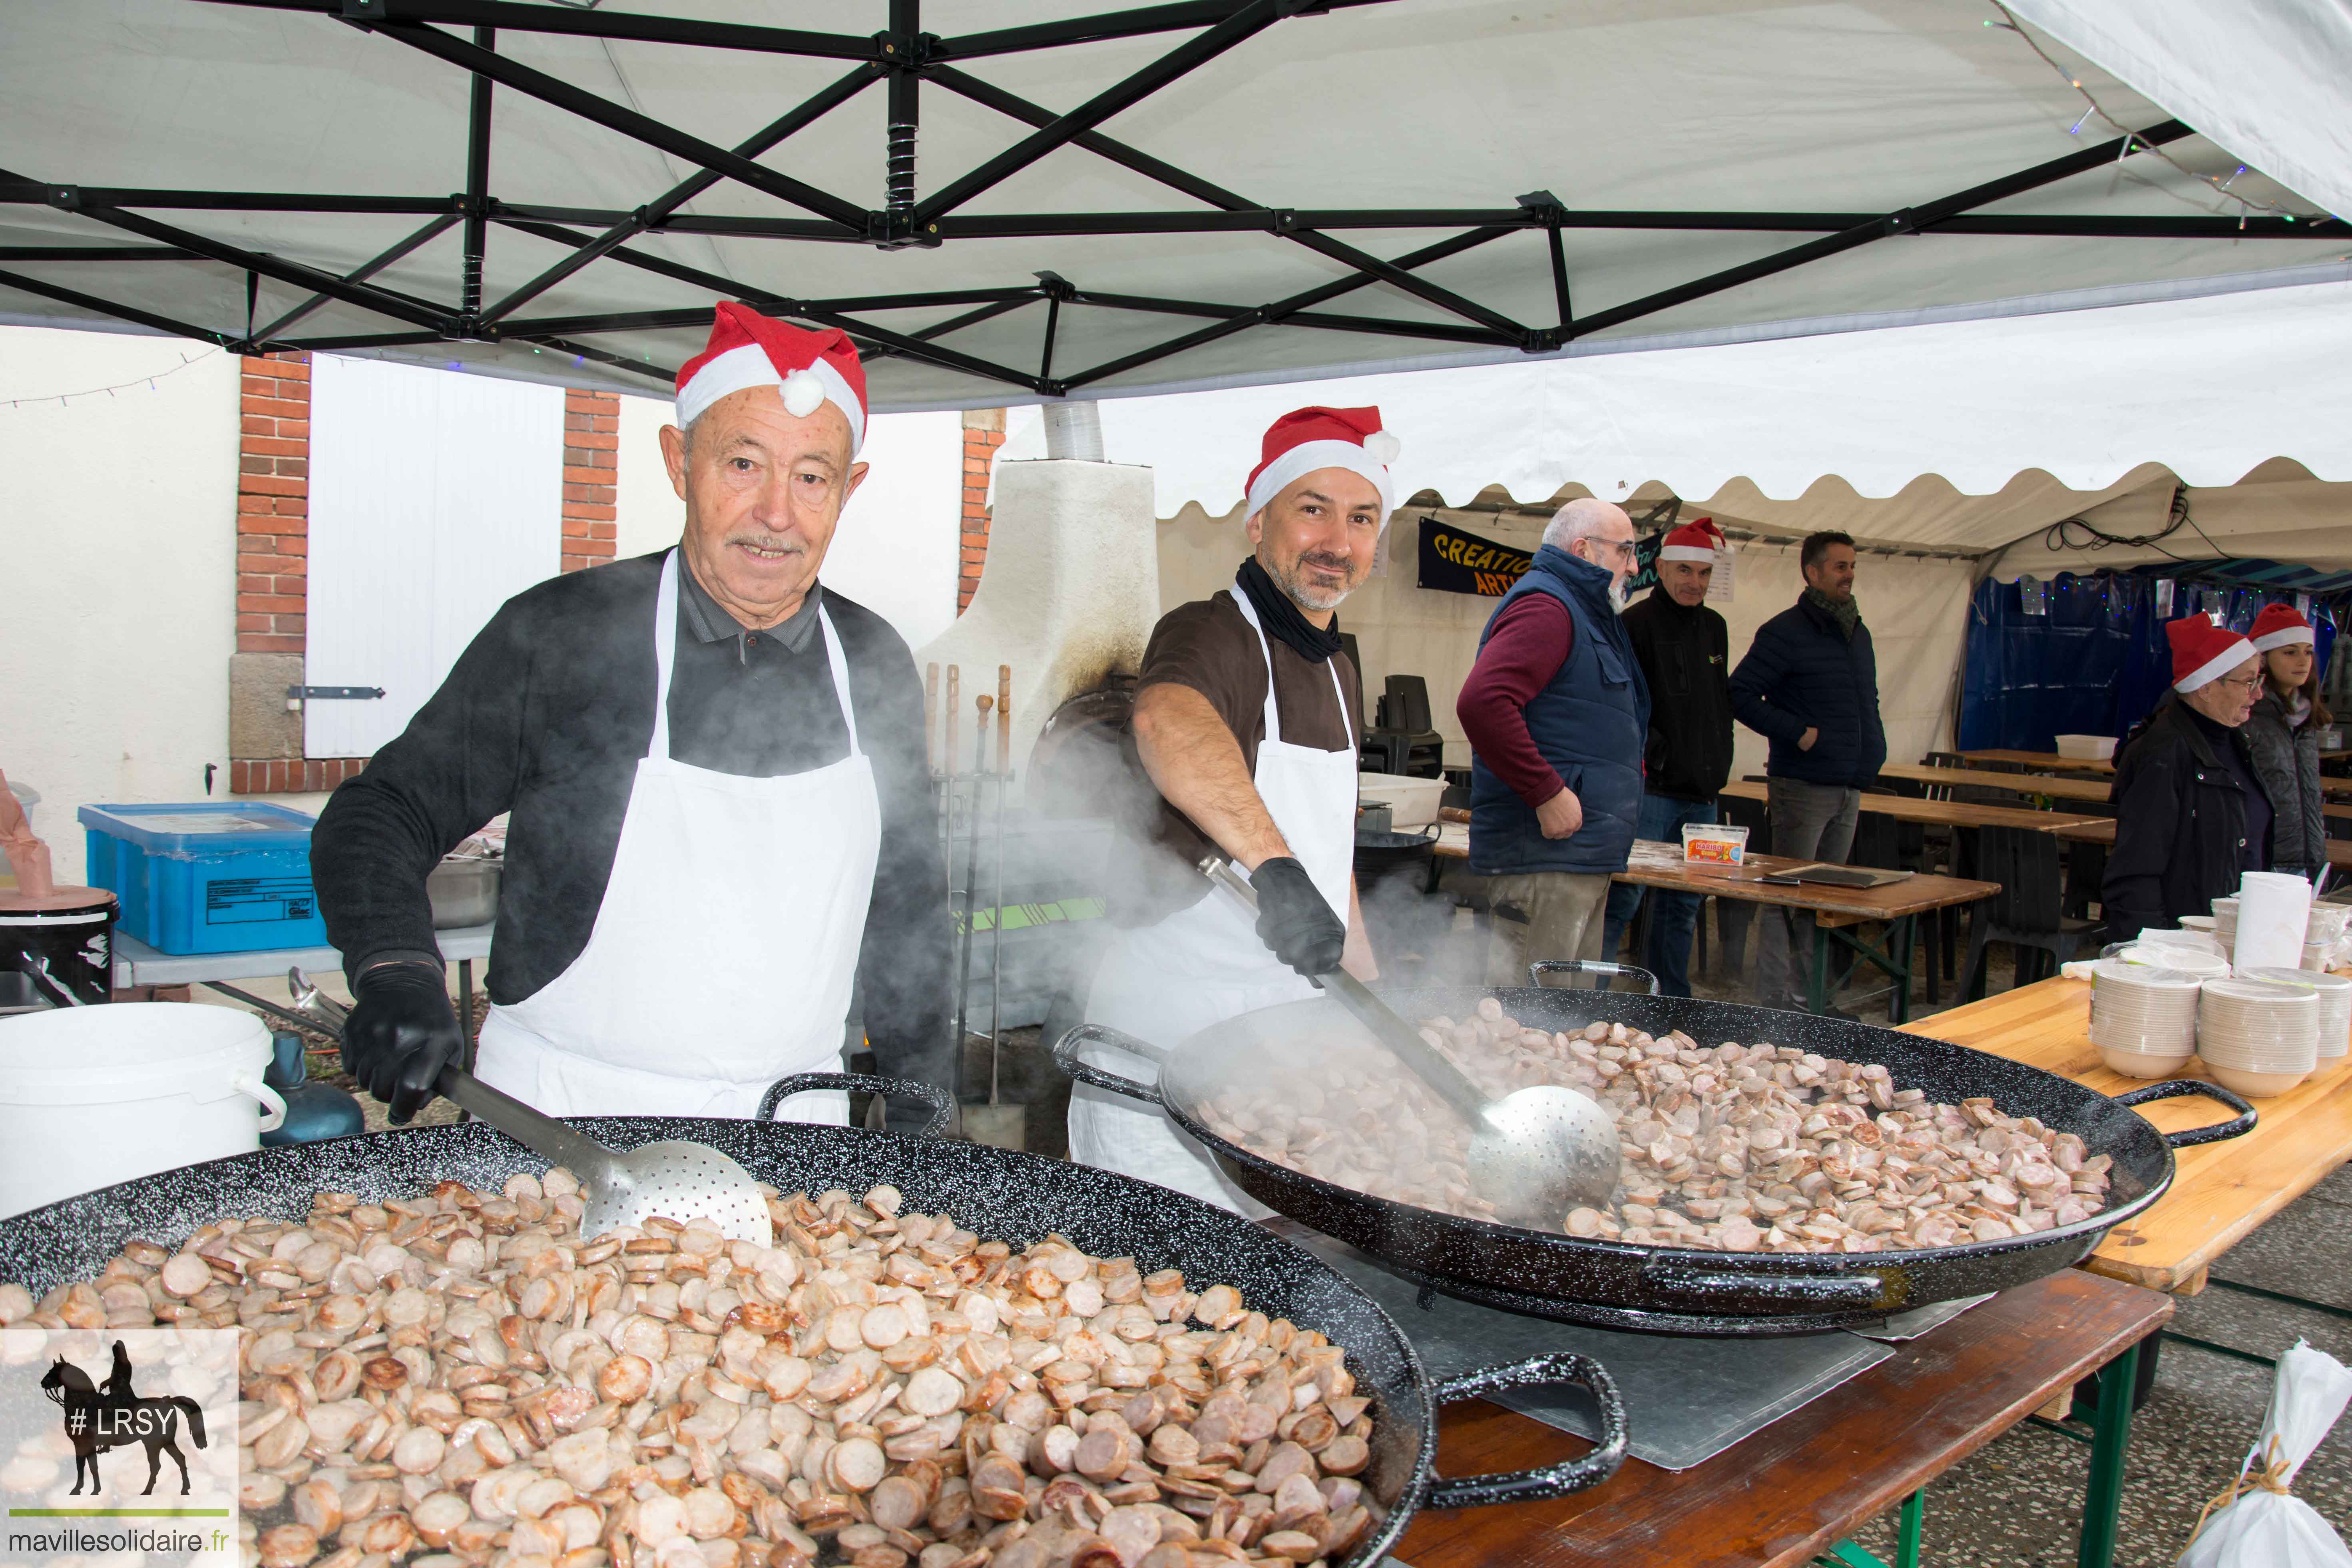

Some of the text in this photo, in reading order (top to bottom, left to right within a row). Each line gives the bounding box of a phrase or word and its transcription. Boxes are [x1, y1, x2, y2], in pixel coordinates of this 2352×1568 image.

[1434, 534, 1532, 573] CREATIO
[1474, 572, 1522, 595] ARTI
[1697, 843, 1723, 851] HARIBO
